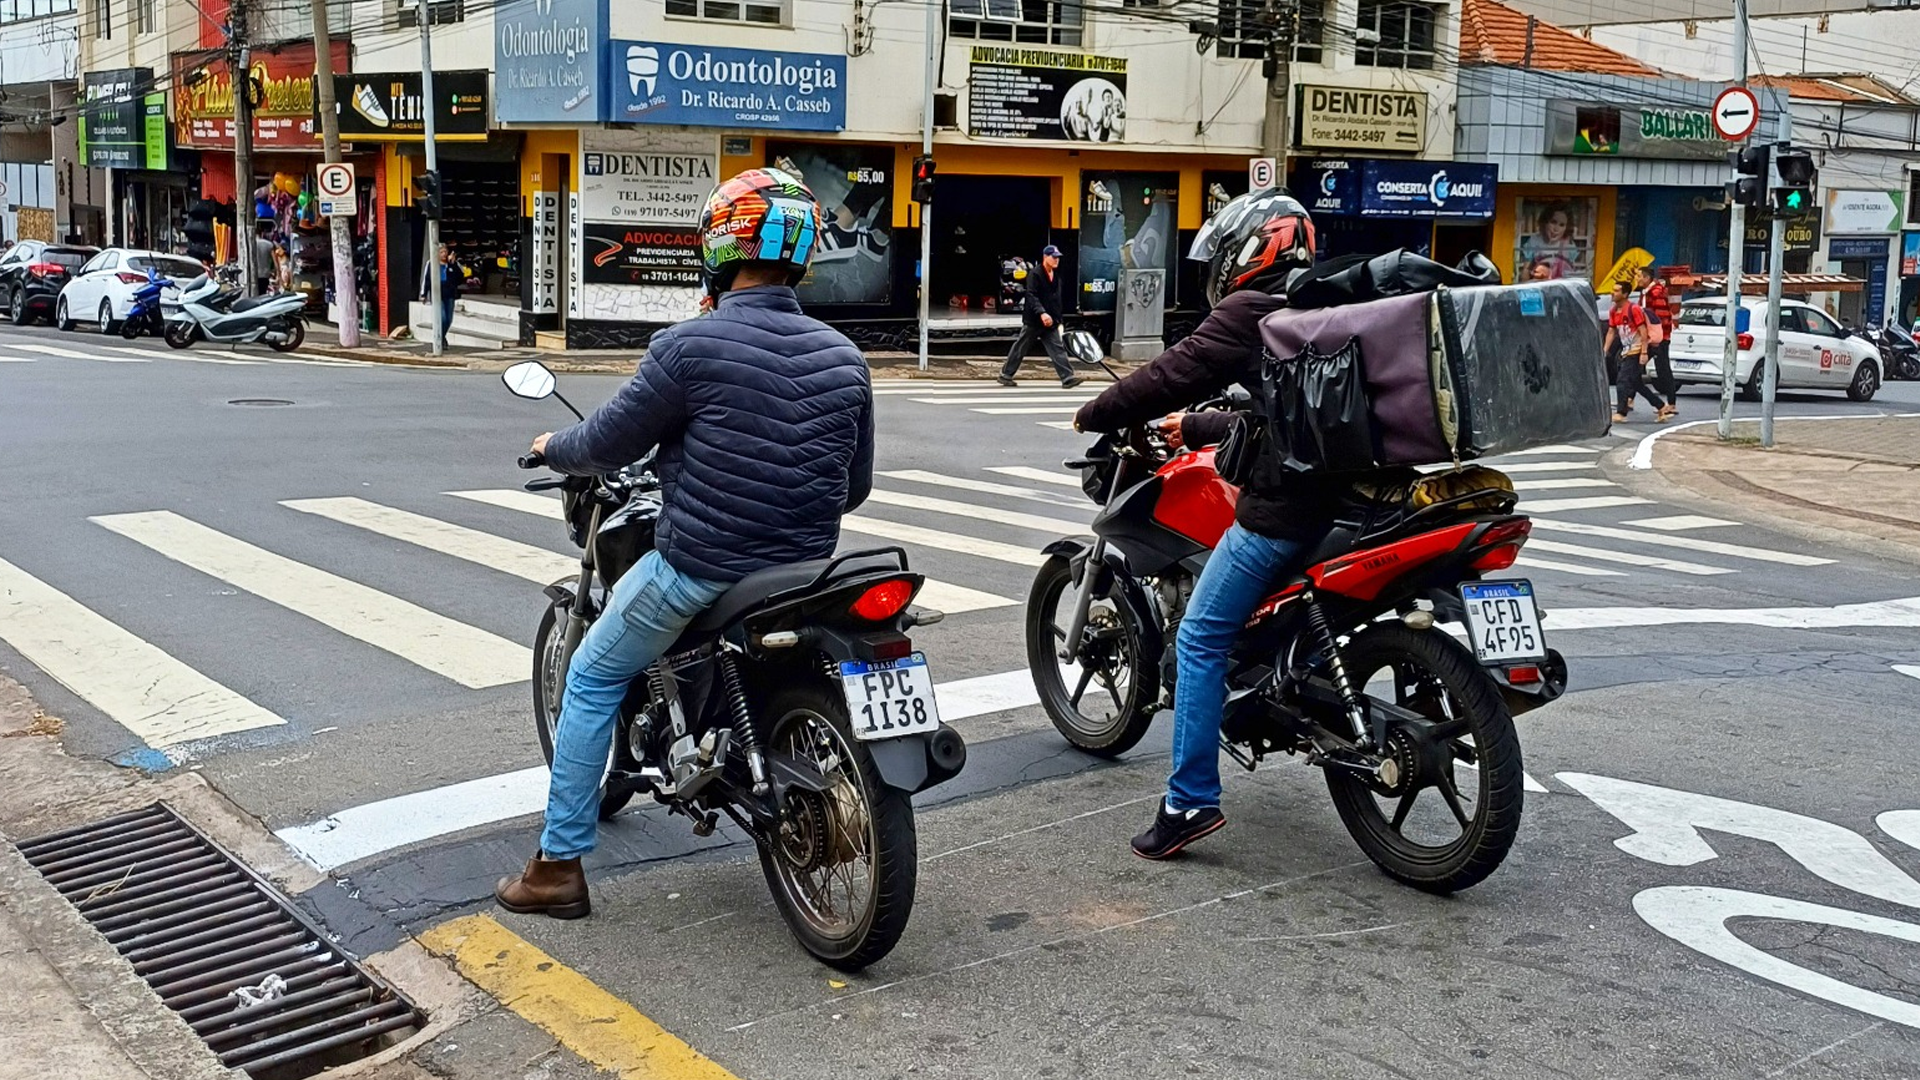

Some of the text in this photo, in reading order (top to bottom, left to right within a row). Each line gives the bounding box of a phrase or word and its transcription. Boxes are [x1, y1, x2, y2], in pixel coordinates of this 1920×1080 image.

[502, 17, 589, 64] Odontologia
[972, 46, 1019, 64] ADVOCACIA
[557, 65, 583, 87] Casseb
[668, 50, 837, 94] Odontologia
[627, 95, 666, 112] desde 1992
[681, 89, 831, 113] Dr. Ricardo A. Casseb
[1312, 89, 1418, 118] DENTISTA
[1323, 115, 1345, 124] Ricardo
[1312, 128, 1385, 142] Fone: 3442-5497
[605, 153, 712, 178] DENTISTA
[1257, 166, 1267, 181] E
[1312, 161, 1349, 169] CONSERTA
[330, 172, 342, 189] E
[1376, 182, 1428, 195] CONSERTA
[617, 190, 699, 203] TEL. 3442-5497
[640, 207, 696, 218] 97107-5497
[705, 217, 753, 240] NORISK
[1746, 229, 1812, 241] RO OURO
[543, 197, 556, 308] DENTISTA
[628, 256, 677, 265] TRABALHISTA
[1834, 352, 1852, 366] città
[1362, 552, 1400, 571] YAMAHA
[1483, 589, 1510, 598] BRASIL
[1481, 599, 1522, 624] CFD
[1485, 626, 1535, 653] 4F95
[867, 660, 900, 671] BRASIL
[862, 669, 914, 701] FPC
[862, 697, 927, 732] 1I38
